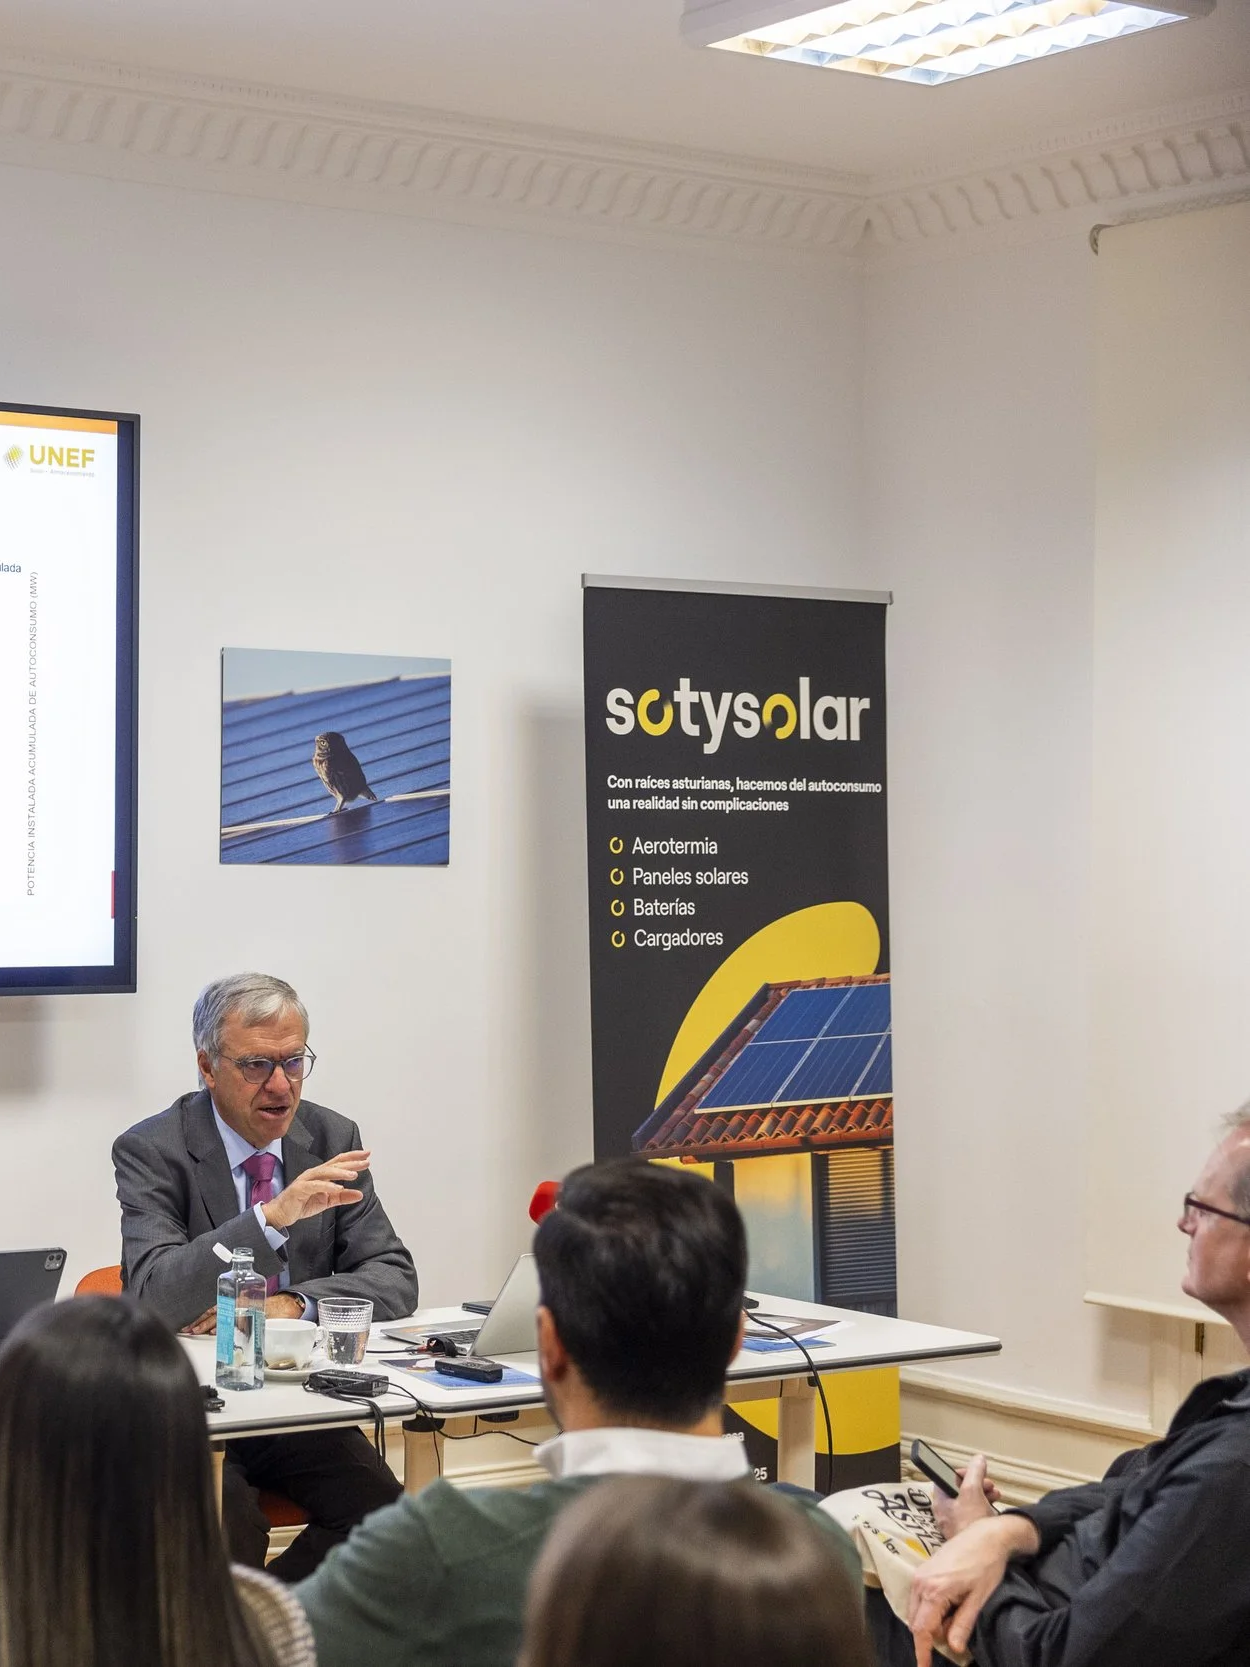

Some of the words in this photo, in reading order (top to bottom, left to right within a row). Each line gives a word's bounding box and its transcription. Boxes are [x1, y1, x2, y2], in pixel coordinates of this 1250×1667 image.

[29, 444, 95, 469] UNEF
[29, 571, 39, 599] (MW)
[28, 600, 38, 688] AUTOCONSUMO
[28, 690, 37, 705] DE
[606, 677, 870, 754] sotysolar
[28, 707, 37, 776] ACUMULADA
[607, 775, 632, 788] Con
[635, 776, 670, 789] raíces
[672, 776, 734, 792] asturianas,
[736, 777, 787, 790] hacemos
[789, 777, 806, 792] del
[808, 780, 881, 792] autoconsumo
[27, 778, 36, 838] INSTALADA
[608, 799, 630, 810] una
[633, 797, 680, 810] realidad
[681, 797, 698, 810] sin
[700, 798, 789, 813] complicaciones
[632, 837, 717, 854] Aerotermia
[26, 840, 36, 896] POTENCIA
[634, 868, 691, 885] Paneles
[696, 867, 748, 884] solares
[634, 898, 695, 915] Baterías
[634, 928, 723, 950] Cargadores
